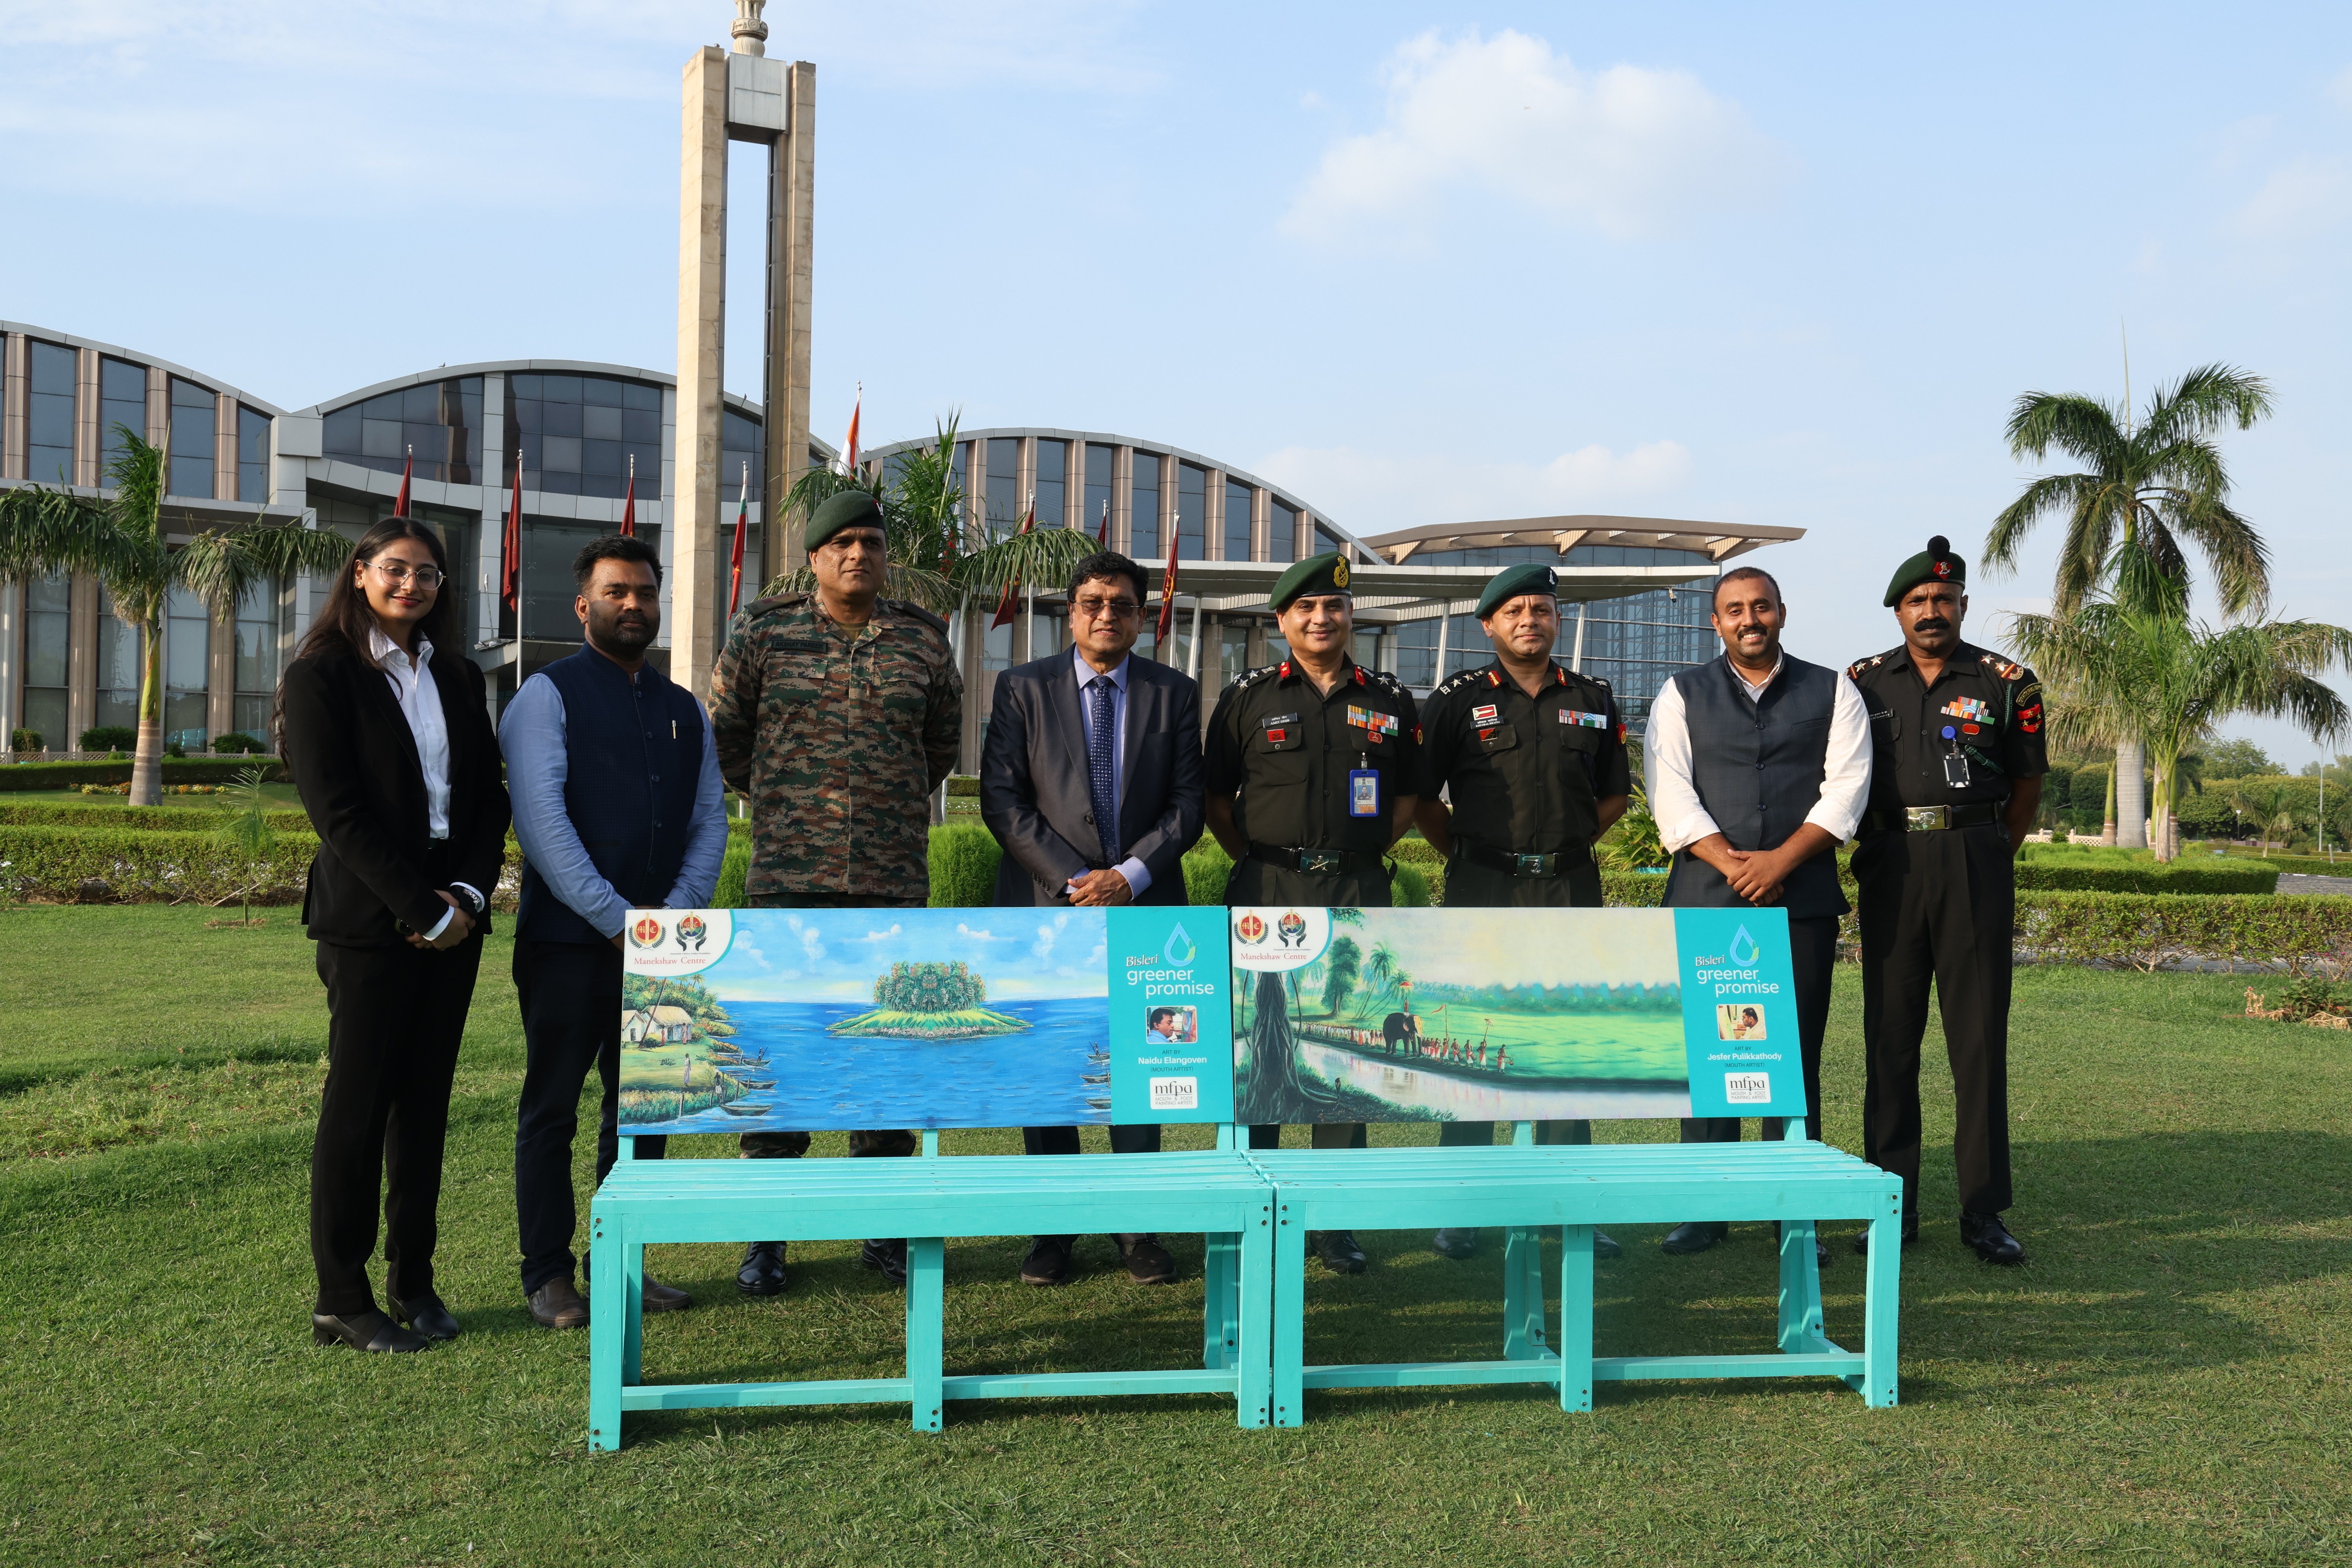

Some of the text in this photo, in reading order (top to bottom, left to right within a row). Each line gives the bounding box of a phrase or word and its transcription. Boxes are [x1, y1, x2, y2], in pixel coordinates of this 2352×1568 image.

[1439, 685, 1451, 695] JAT
[1126, 954, 1158, 967] Bisleri
[1695, 955, 1725, 967] Bisleri
[1127, 969, 1194, 985] greener
[1697, 969, 1759, 984] greener
[1146, 980, 1214, 999] promise
[1715, 980, 1779, 998] promise
[1164, 1056, 1207, 1065] Elangoven
[1732, 1053, 1782, 1061] Pulikkathody
[1155, 1081, 1192, 1096] mfpa
[1730, 1076, 1765, 1091] mfpa
